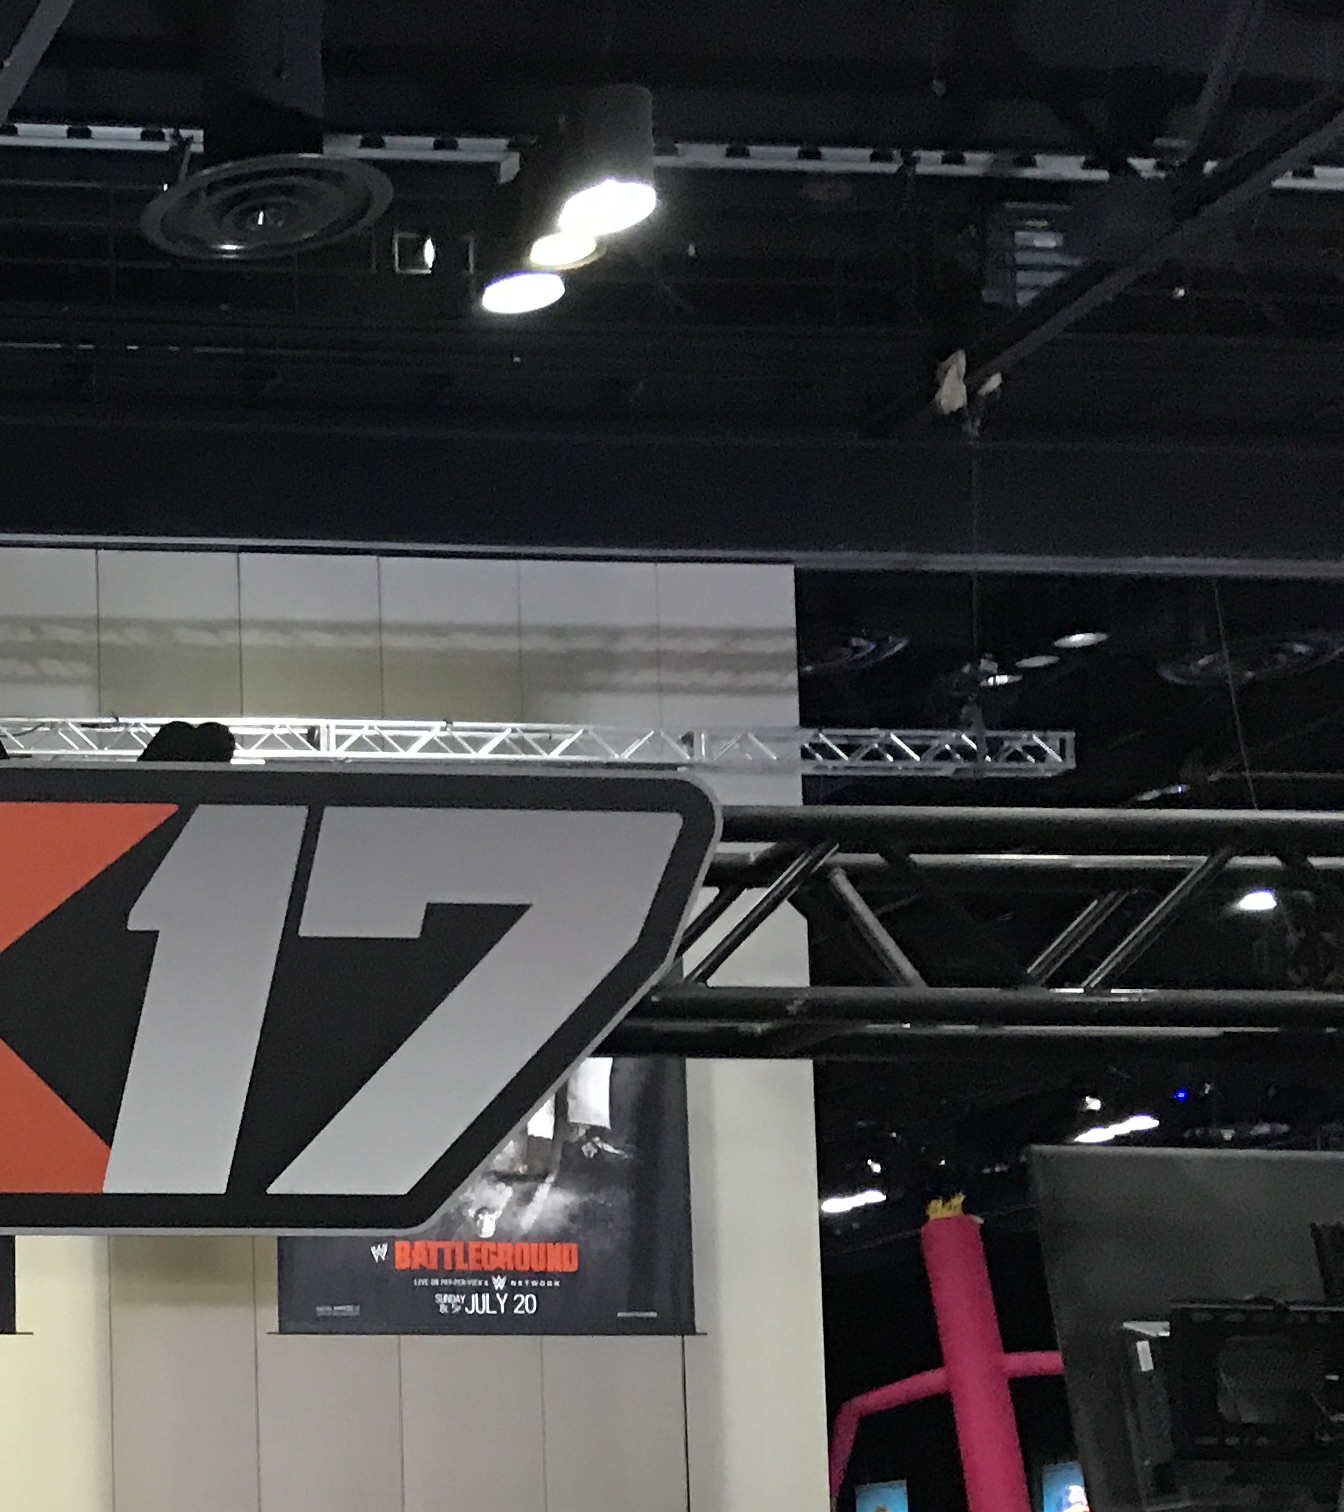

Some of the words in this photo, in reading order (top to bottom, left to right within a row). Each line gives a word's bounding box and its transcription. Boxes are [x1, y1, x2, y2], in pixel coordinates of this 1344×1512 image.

[394, 1240, 579, 1272] BATTLEGROUND
[464, 1293, 508, 1315] JULY
[513, 1293, 538, 1315] 20
